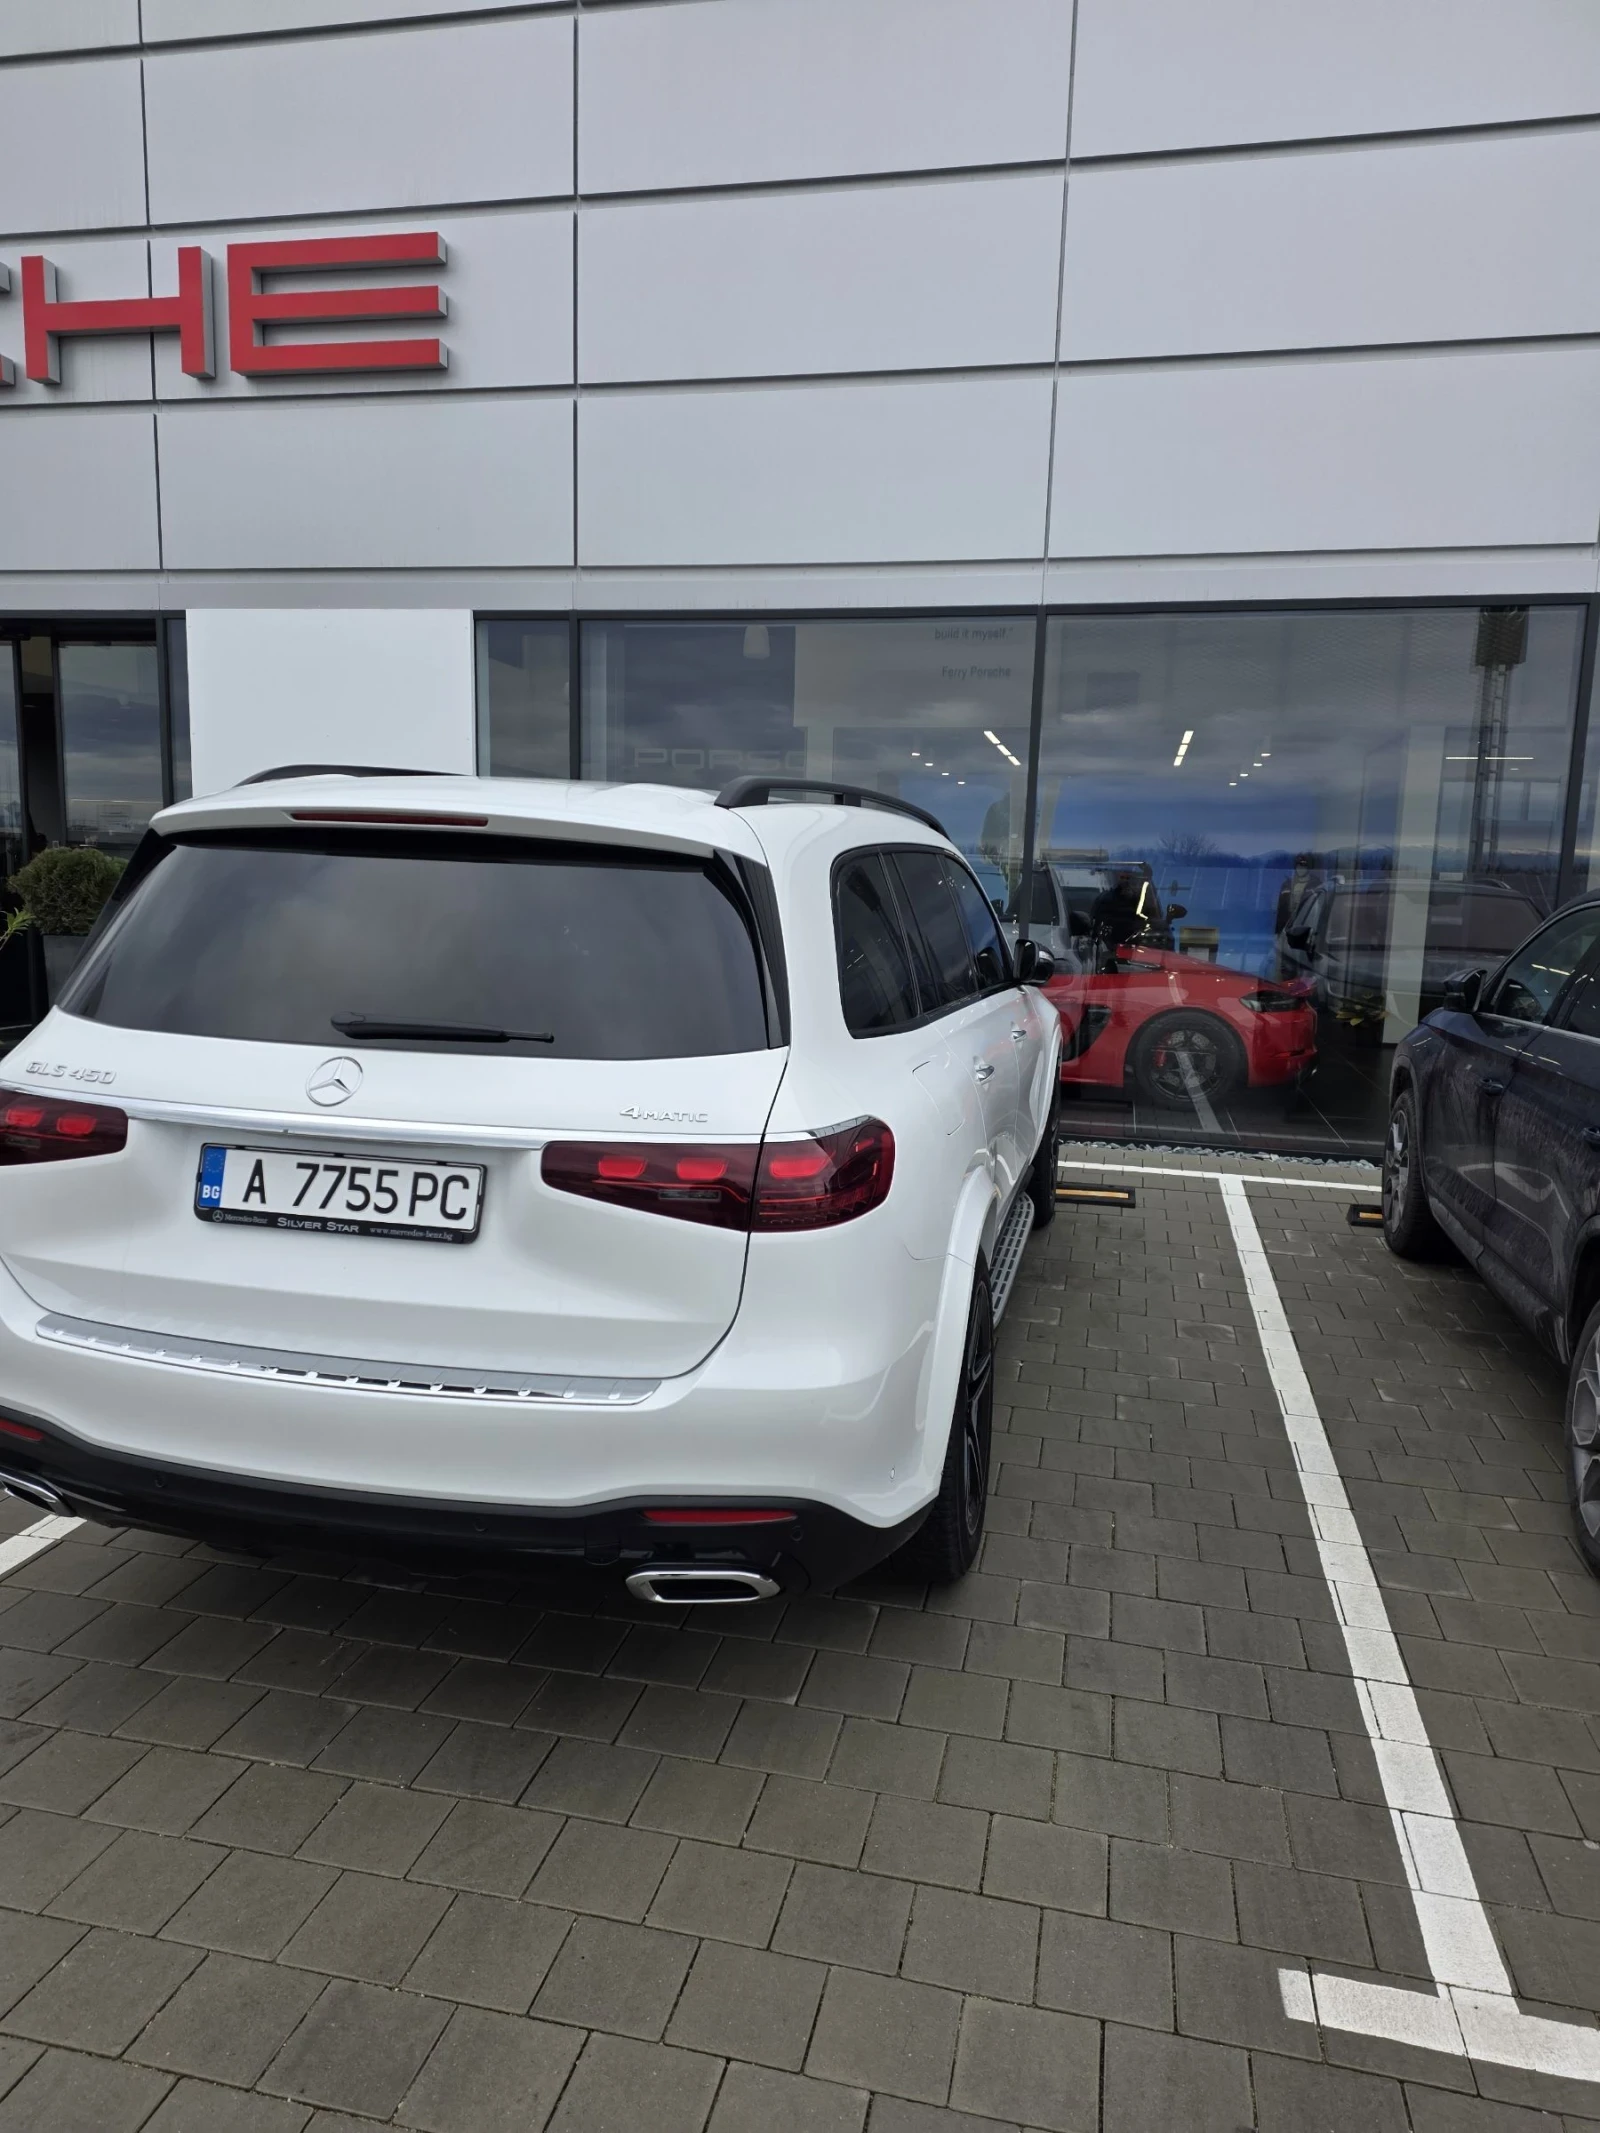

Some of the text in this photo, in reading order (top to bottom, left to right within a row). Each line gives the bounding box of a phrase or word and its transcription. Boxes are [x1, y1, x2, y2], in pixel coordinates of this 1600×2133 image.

[0, 231, 447, 386] HE
[942, 665, 967, 680] Ferry
[25, 1061, 117, 1085] GLS 450
[619, 1103, 709, 1123] 4MATIC
[202, 1184, 220, 1199] BG
[242, 1158, 470, 1220] A 7755 PC
[224, 1212, 268, 1225] Mercedes-Benz
[369, 1227, 453, 1241] www.mercedes-benz.bg
